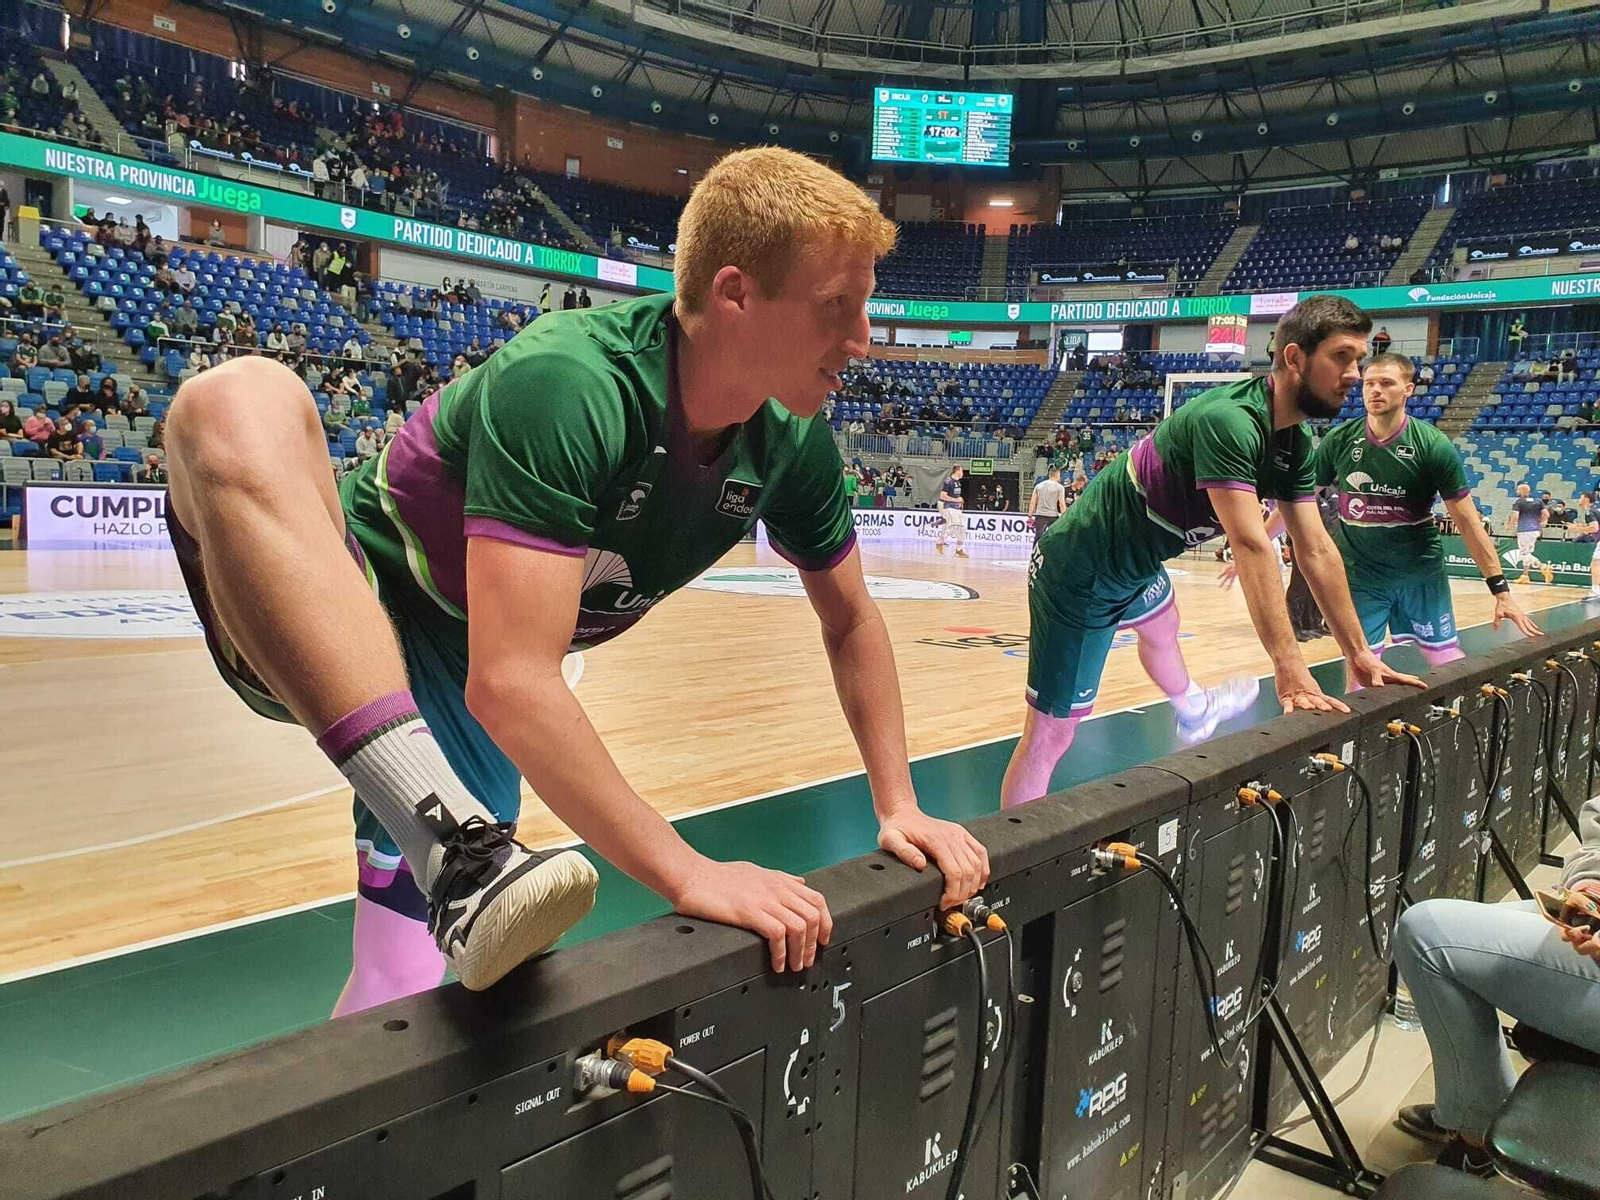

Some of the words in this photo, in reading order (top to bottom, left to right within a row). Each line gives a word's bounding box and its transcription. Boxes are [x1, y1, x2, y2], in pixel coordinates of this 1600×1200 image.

[929, 127, 957, 138] 17:02
[45, 148, 115, 180] NUESTRA
[120, 164, 196, 197] PROVINCIA
[199, 177, 261, 212] Juega
[393, 218, 453, 249] PARTIDO
[457, 230, 521, 262] DEDICADO
[525, 245, 534, 265] A
[540, 248, 582, 273] TORROX
[1551, 278, 1600, 296] NUESTR
[864, 302, 905, 316] ROVINCIA
[907, 301, 949, 320] Juega
[1051, 303, 1103, 320] PARTIDO
[1107, 300, 1168, 318] DEDICADO
[1172, 300, 1180, 316] A
[1187, 297, 1232, 316] TORROX
[1210, 316, 1236, 325] 17:02
[1210, 327, 1232, 343] 24
[726, 490, 746, 503] liga
[1370, 483, 1407, 496] Unicaja
[51, 495, 166, 518] CUMPL
[722, 502, 755, 514] endes
[93, 522, 152, 535] HAZLO
[854, 513, 894, 526] ORMAS
[904, 515, 944, 528] CUMP
[967, 518, 996, 531] LAS
[1001, 519, 1036, 533] NOR
[975, 533, 1003, 542] HAZLO
[1004, 534, 1022, 542] POR
[1164, 826, 1172, 846] 5
[1189, 828, 1200, 861] 6
[830, 982, 851, 1032] 5
[1217, 986, 1243, 1017] RPG
[680, 1031, 701, 1048] POWER
[702, 1024, 715, 1038] OUT
[1088, 1034, 1124, 1066] KABUKILED
[515, 1095, 544, 1115] SIGNAL
[546, 1086, 561, 1101] OUT
[1089, 1072, 1127, 1118] RPG
[906, 1149, 959, 1193] KABUKILED
